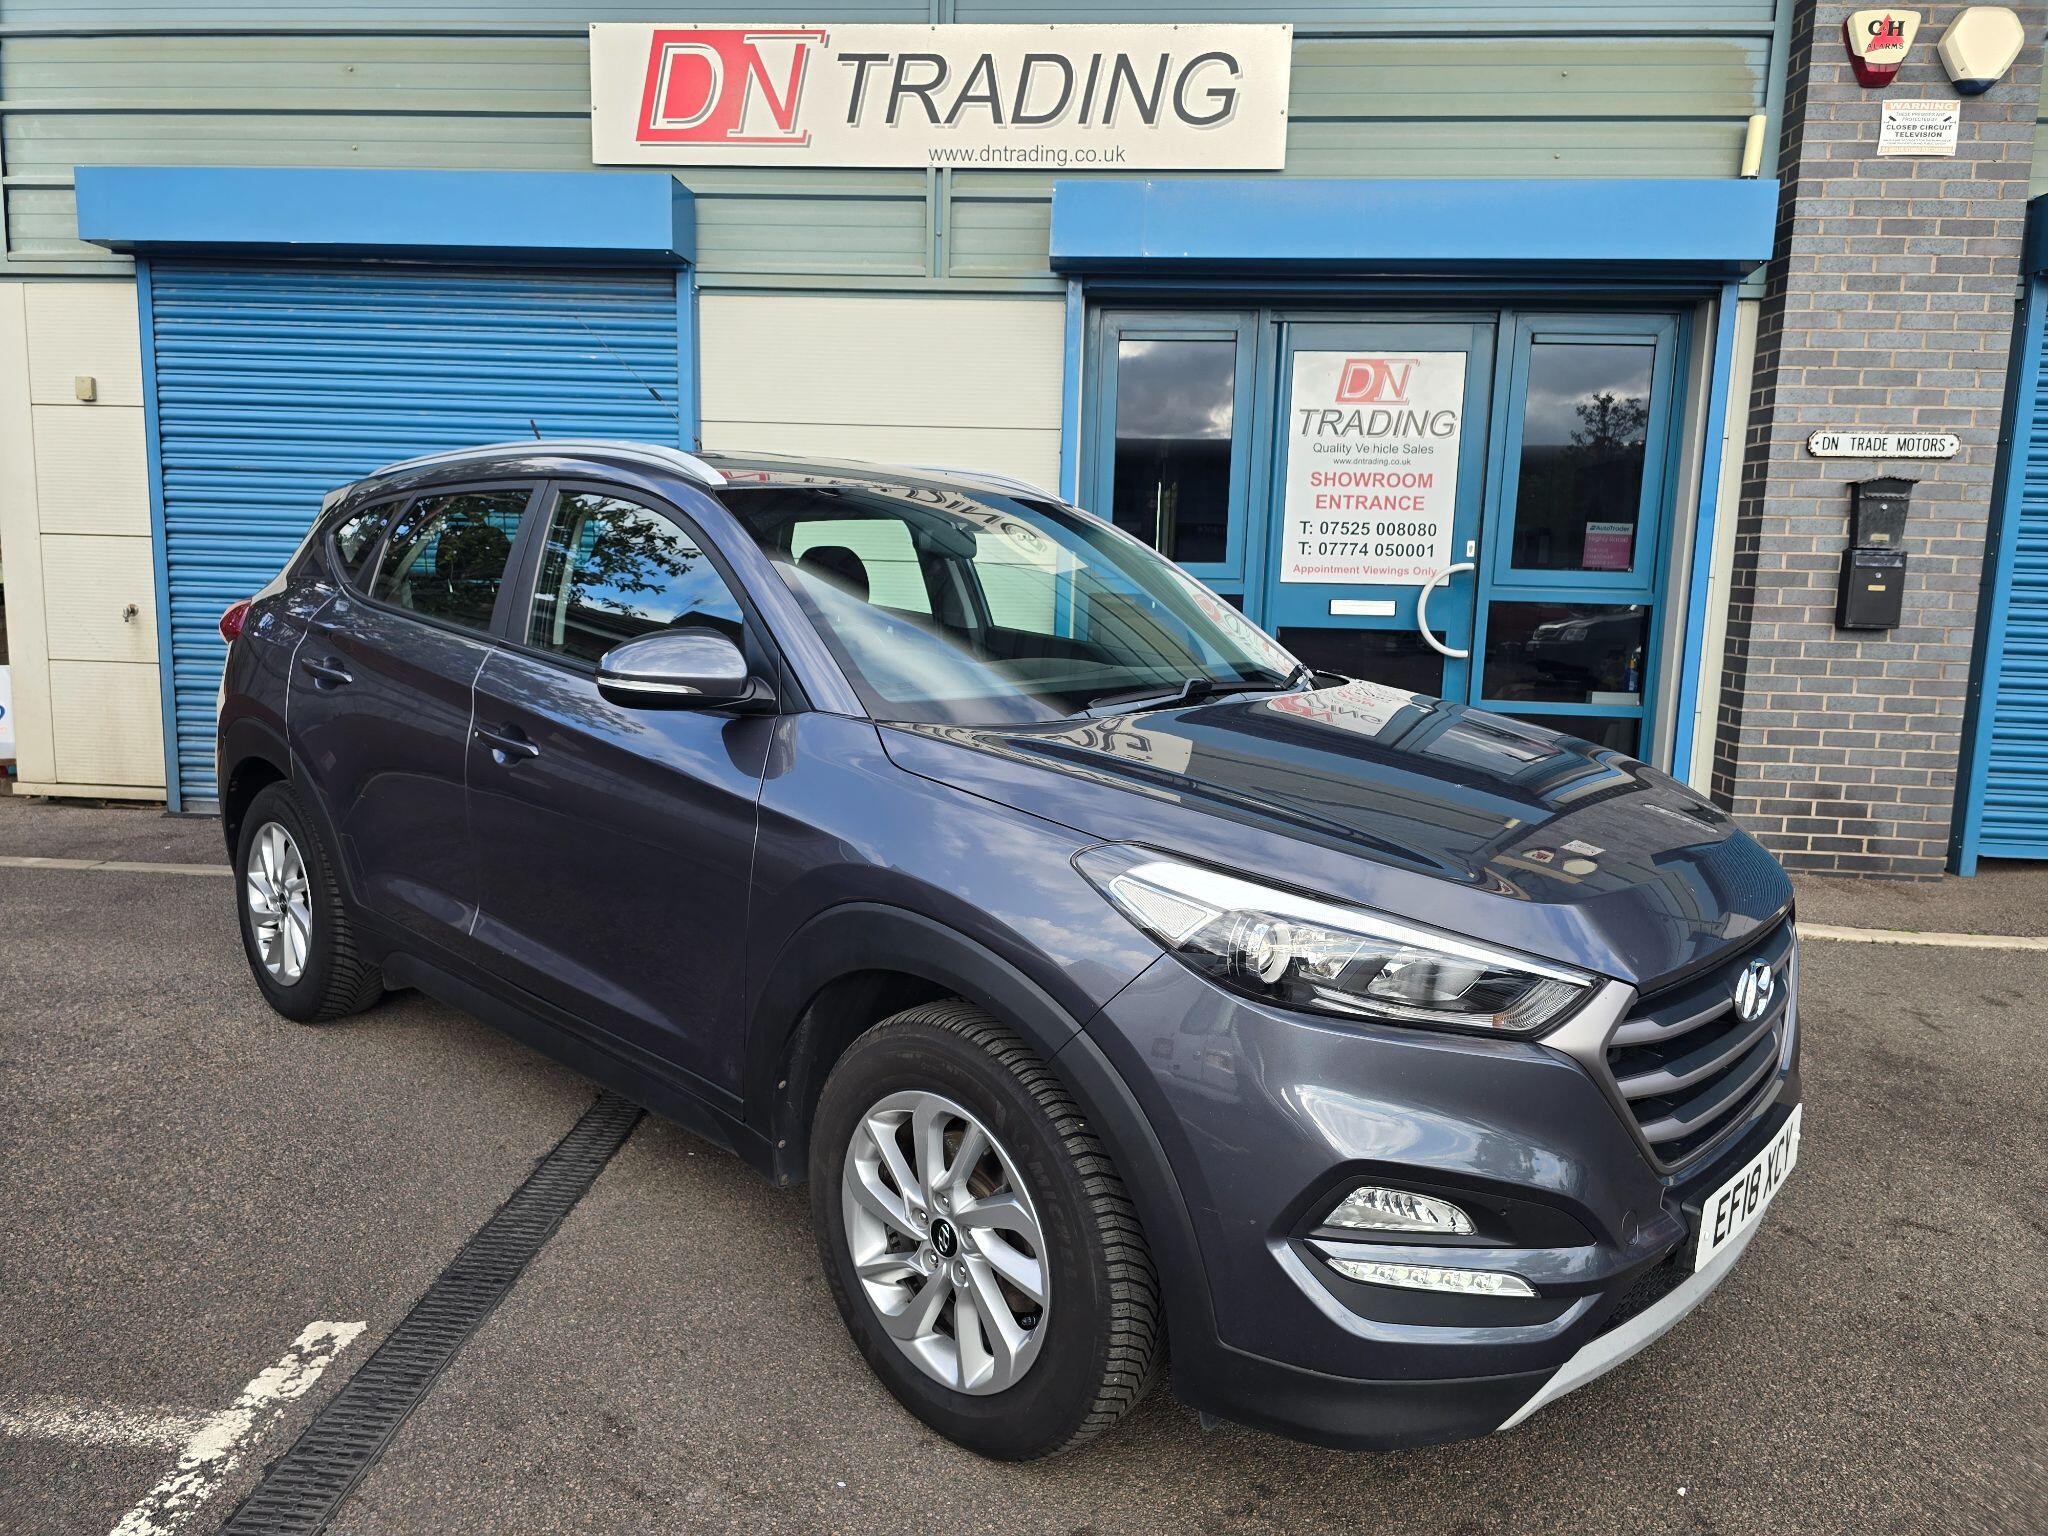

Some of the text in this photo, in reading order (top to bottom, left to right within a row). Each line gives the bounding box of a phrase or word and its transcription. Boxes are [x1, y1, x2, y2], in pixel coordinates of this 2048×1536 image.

[1867, 42, 1904, 50] ALARMS
[650, 32, 1243, 143] DN TRADING
[1890, 102, 1953, 110] WARNING
[928, 144, 1126, 167] www.dntrading.co.uk
[1342, 359, 1420, 402] DN
[1299, 408, 1458, 439] TRADING
[1313, 442, 1434, 456] Quality Vehicle Sales
[1821, 436, 1946, 452] DN TRADE MOTORS
[1333, 457, 1412, 467] www.dntrading.co.uk
[1310, 471, 1434, 489] SHOWROOM
[1315, 494, 1425, 511] ENTRANCE
[1299, 520, 1437, 537] T: 07525 008080
[1298, 541, 1435, 558] T: 07774 050001
[1293, 564, 1437, 578] Appointment Viewings Only
[1712, 1122, 1794, 1249] EF18 XCY
